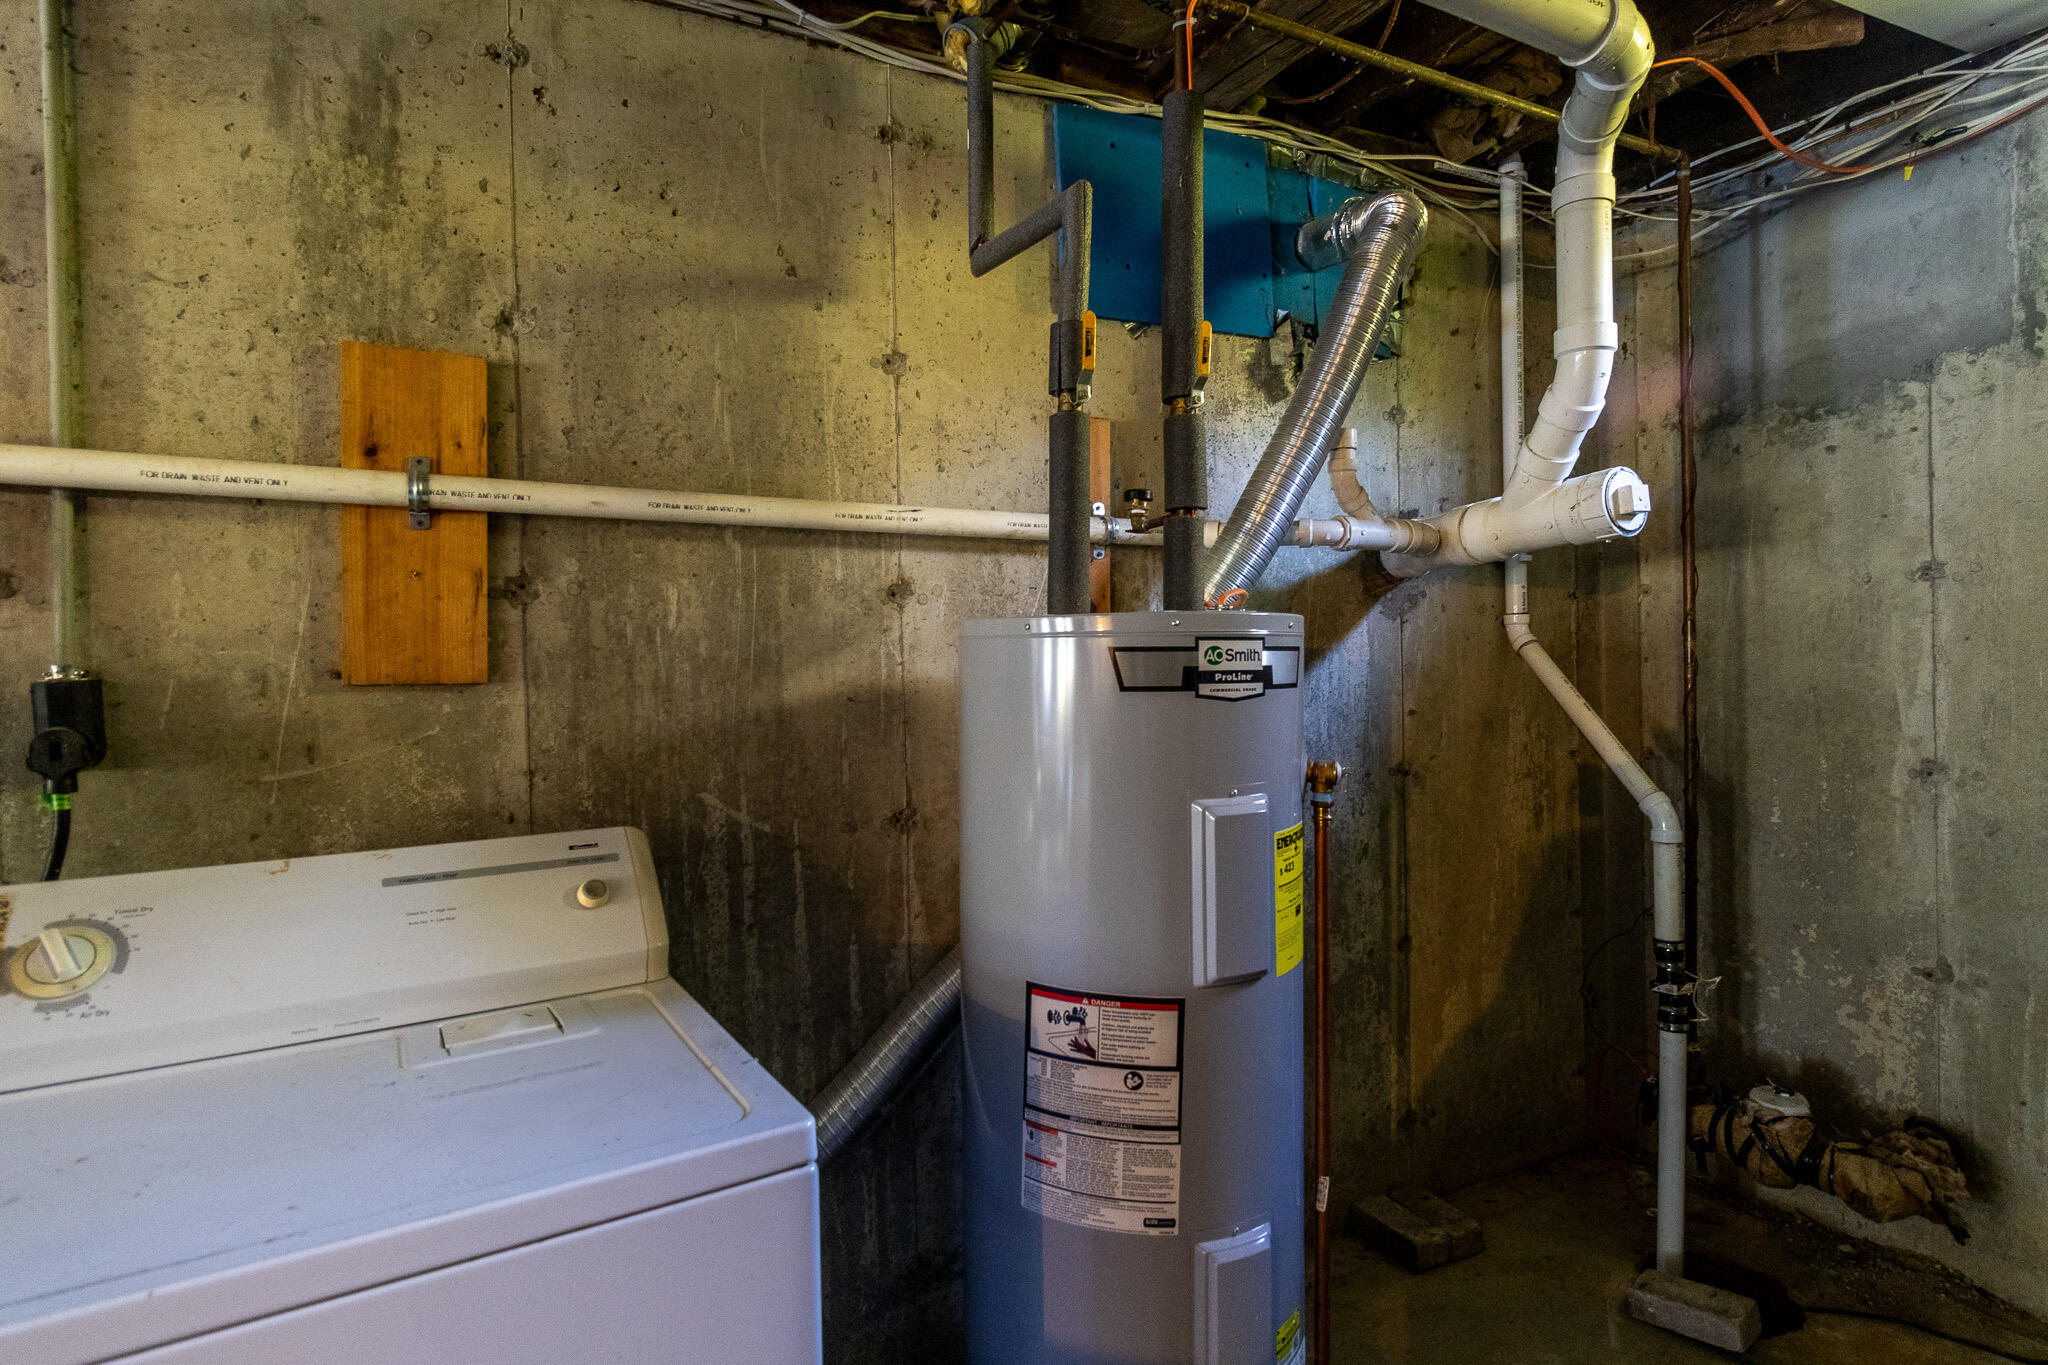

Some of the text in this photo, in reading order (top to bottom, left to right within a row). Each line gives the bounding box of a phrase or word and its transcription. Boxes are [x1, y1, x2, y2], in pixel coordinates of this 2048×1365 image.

[140, 470, 288, 486] FOR DRAIN WASTE AND VENT ONLY
[450, 490, 475, 498] WASTE
[1214, 672, 1252, 681] ProLine
[140, 905, 154, 913] Dry
[1090, 1000, 1121, 1008] DANGER
[95, 1009, 110, 1018] Dry
